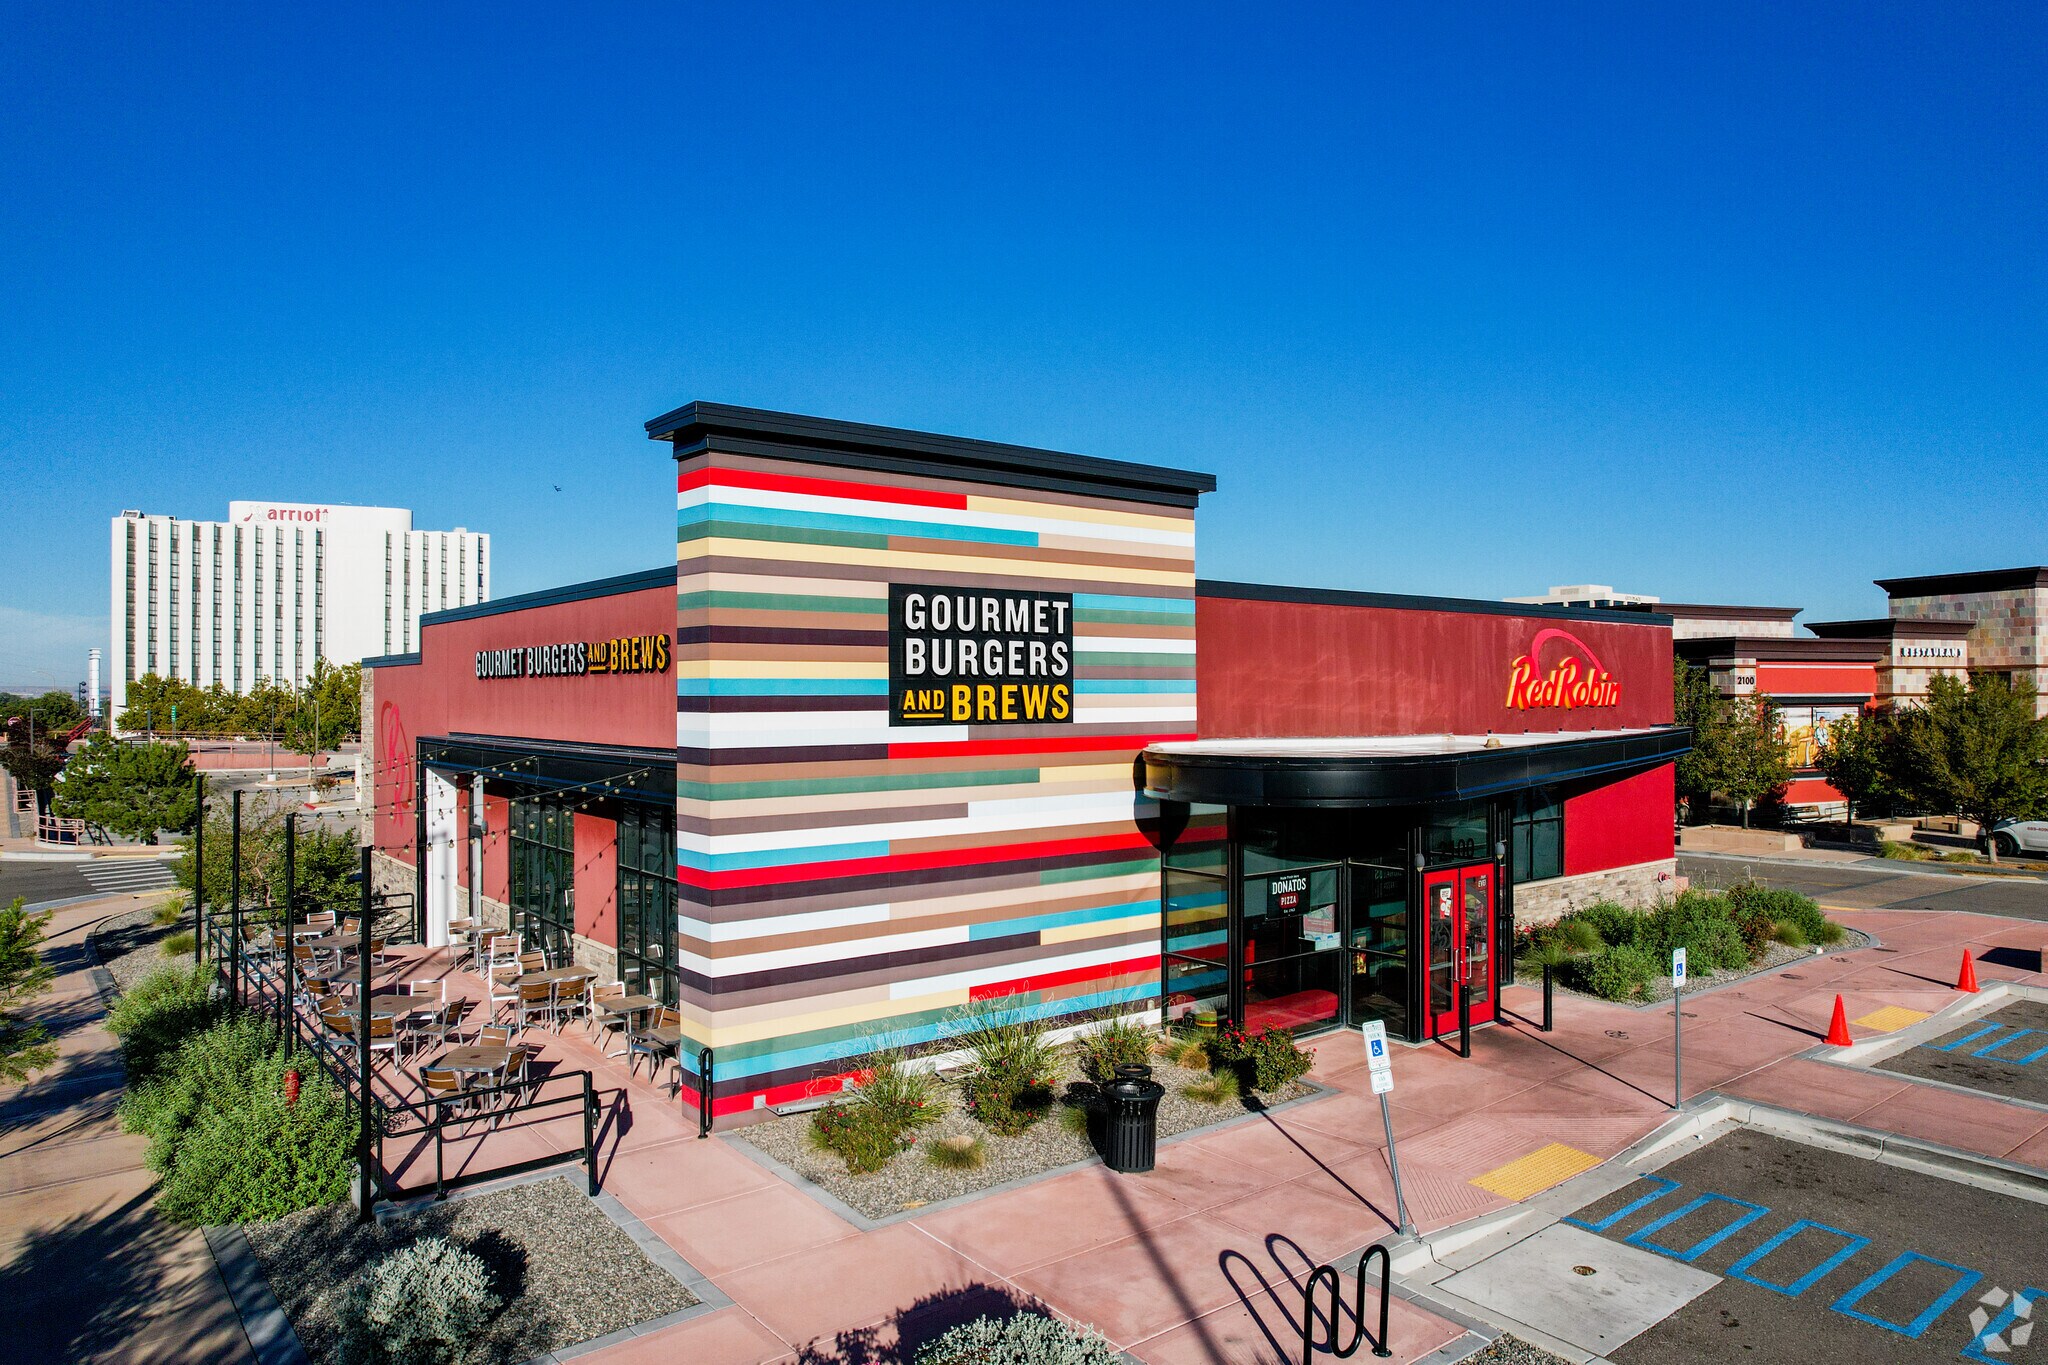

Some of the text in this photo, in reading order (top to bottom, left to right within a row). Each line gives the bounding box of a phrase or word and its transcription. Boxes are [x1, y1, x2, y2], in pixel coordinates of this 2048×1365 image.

[905, 593, 1069, 634] GOURMET
[475, 634, 667, 678] GOURMET BURGERS AND BREWS
[905, 637, 1069, 677] BURGERS
[1901, 648, 1964, 657] RESTAURANT
[1737, 676, 1755, 685] 2100
[903, 684, 1069, 721] AND BREWS
[1271, 878, 1307, 895] DONATOS
[1280, 896, 1297, 906] PIZZA
